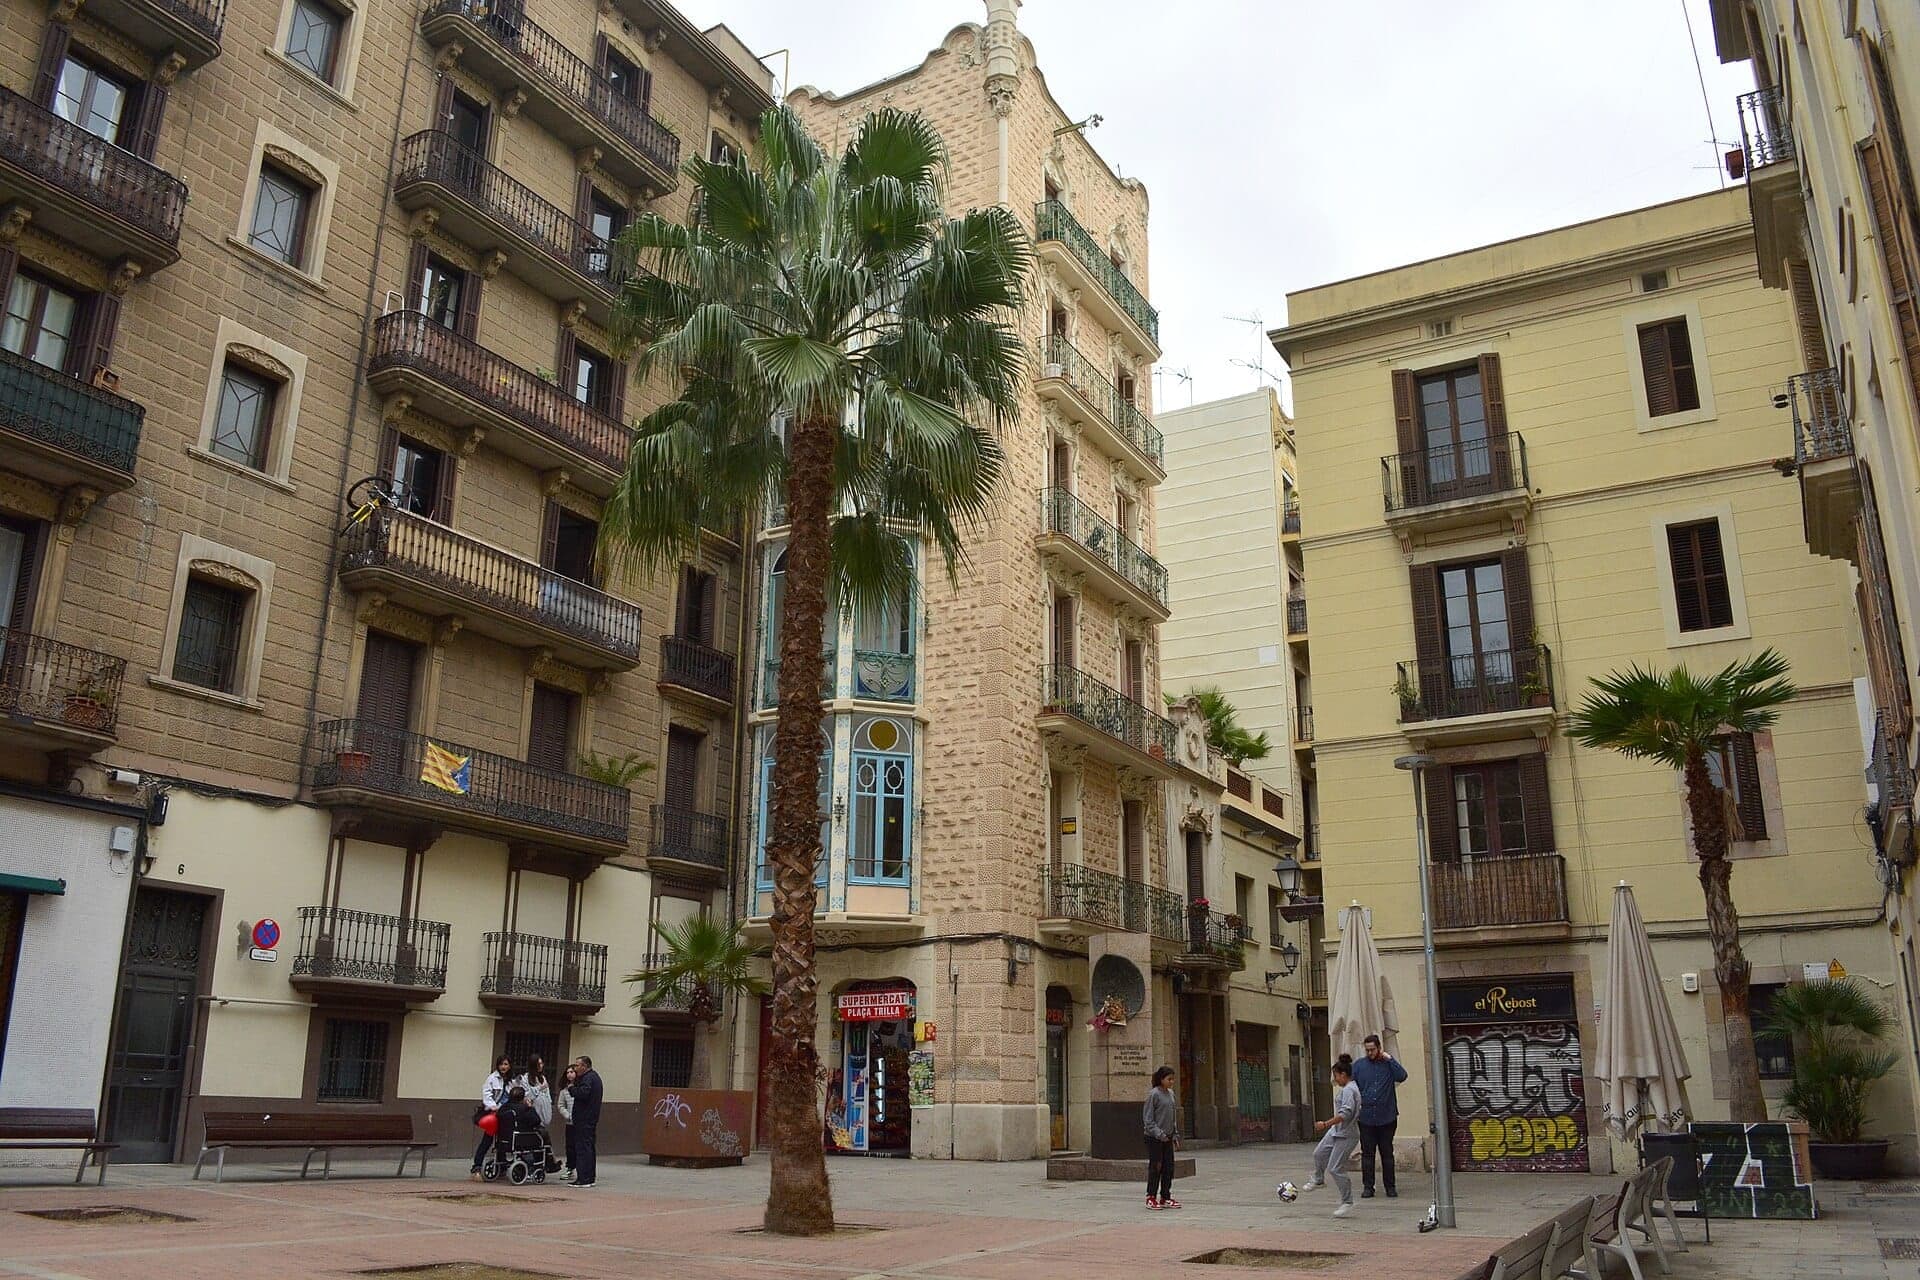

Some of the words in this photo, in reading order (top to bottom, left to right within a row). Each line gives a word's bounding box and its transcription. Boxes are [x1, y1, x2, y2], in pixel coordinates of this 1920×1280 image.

[178, 864, 185, 875] 6
[842, 994, 906, 1007] SUPERMERCAT
[1474, 999, 1487, 1010] el
[1487, 986, 1537, 1014] Rebost
[847, 1006, 872, 1018] PLAÇA
[874, 1005, 900, 1016] TRILLA
